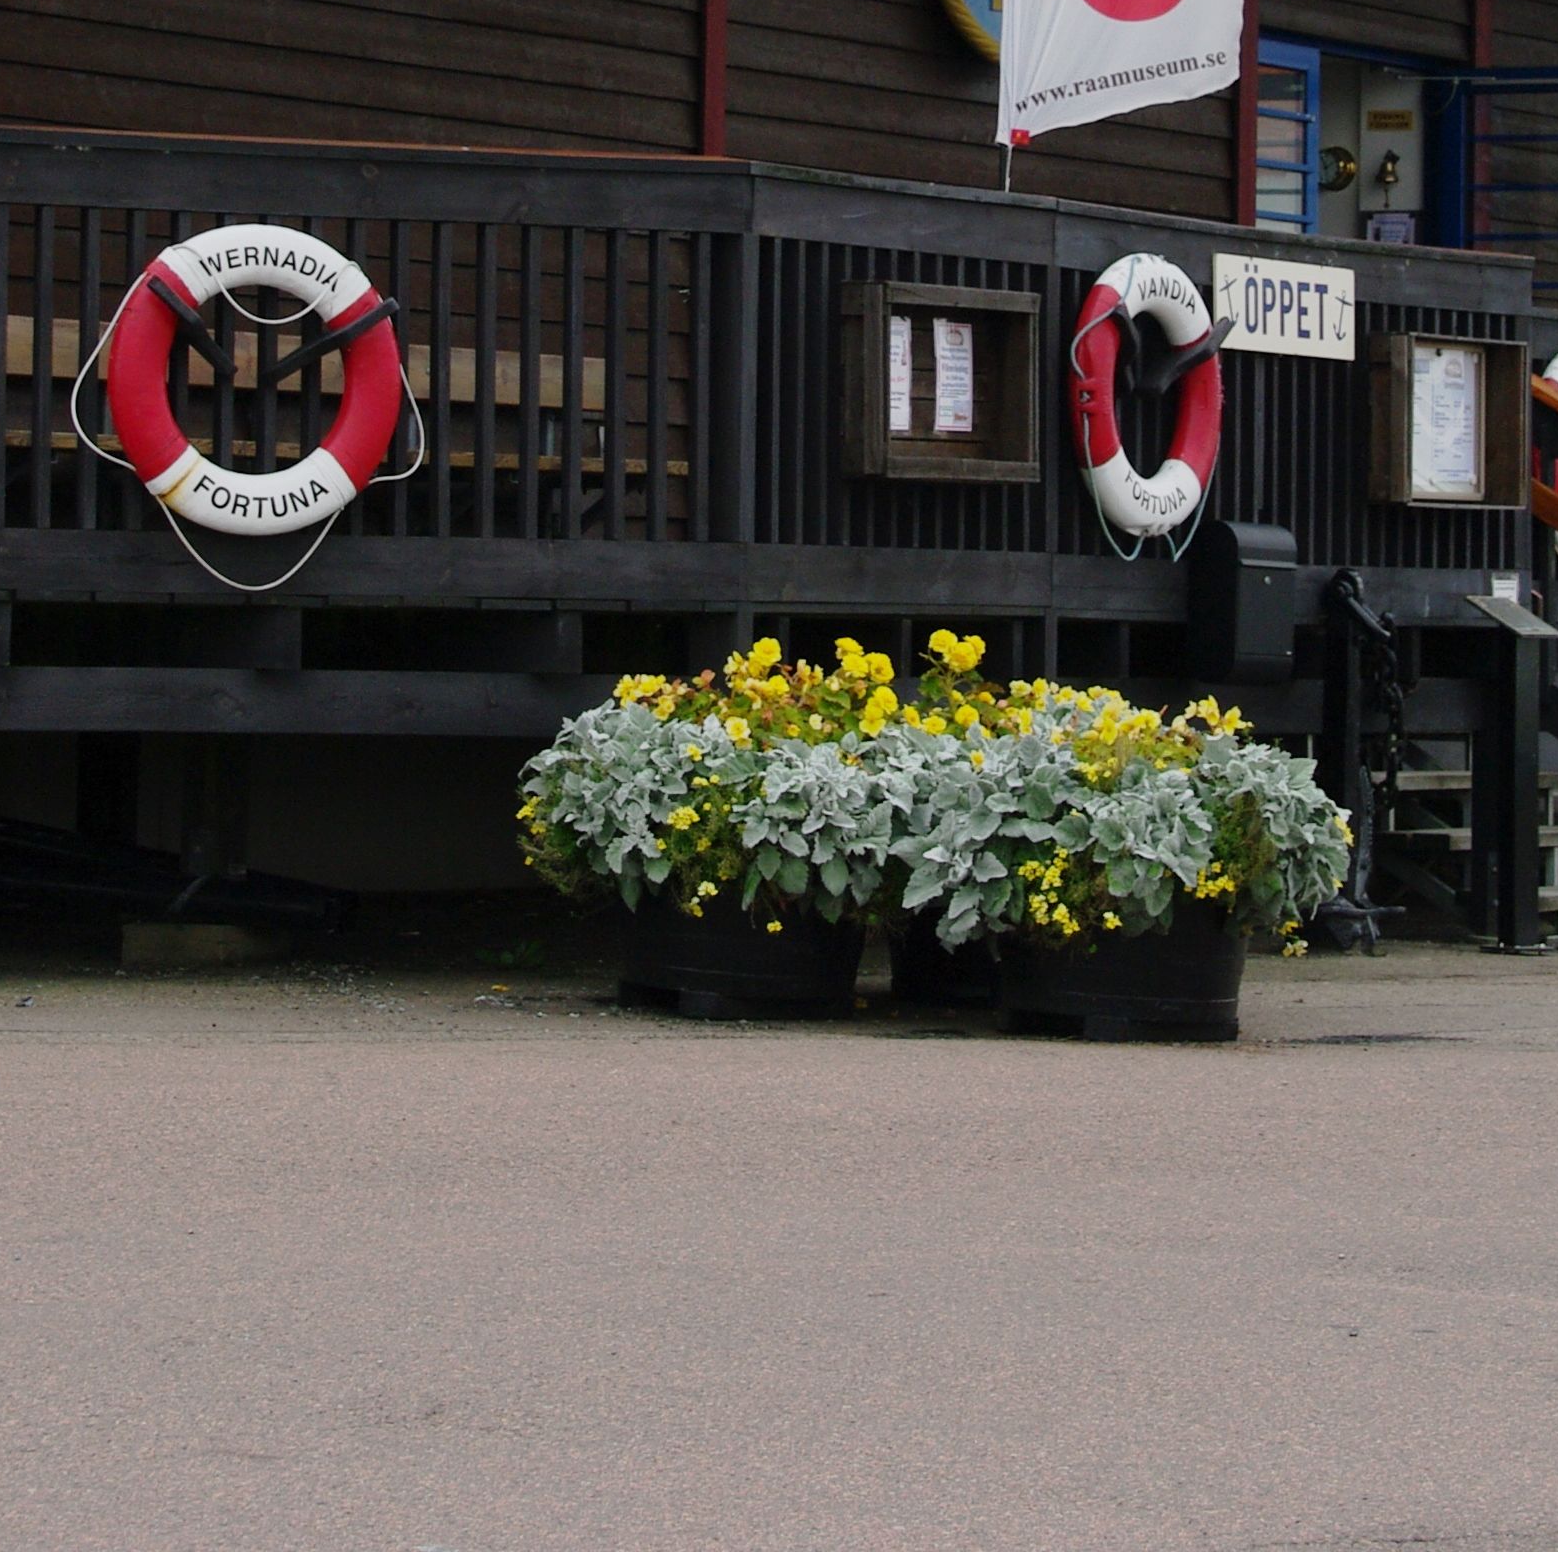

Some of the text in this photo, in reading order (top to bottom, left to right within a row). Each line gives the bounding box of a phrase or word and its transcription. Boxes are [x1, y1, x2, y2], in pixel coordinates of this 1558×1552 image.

[1015, 50, 1227, 115] www.raamuseum.se
[199, 246, 340, 293] WERNADIA
[1137, 276, 1197, 315] VANDIA
[1244, 263, 1328, 341] ÖPPET
[193, 474, 329, 519] FORTUNA
[1124, 470, 1187, 516] FORTUNA
